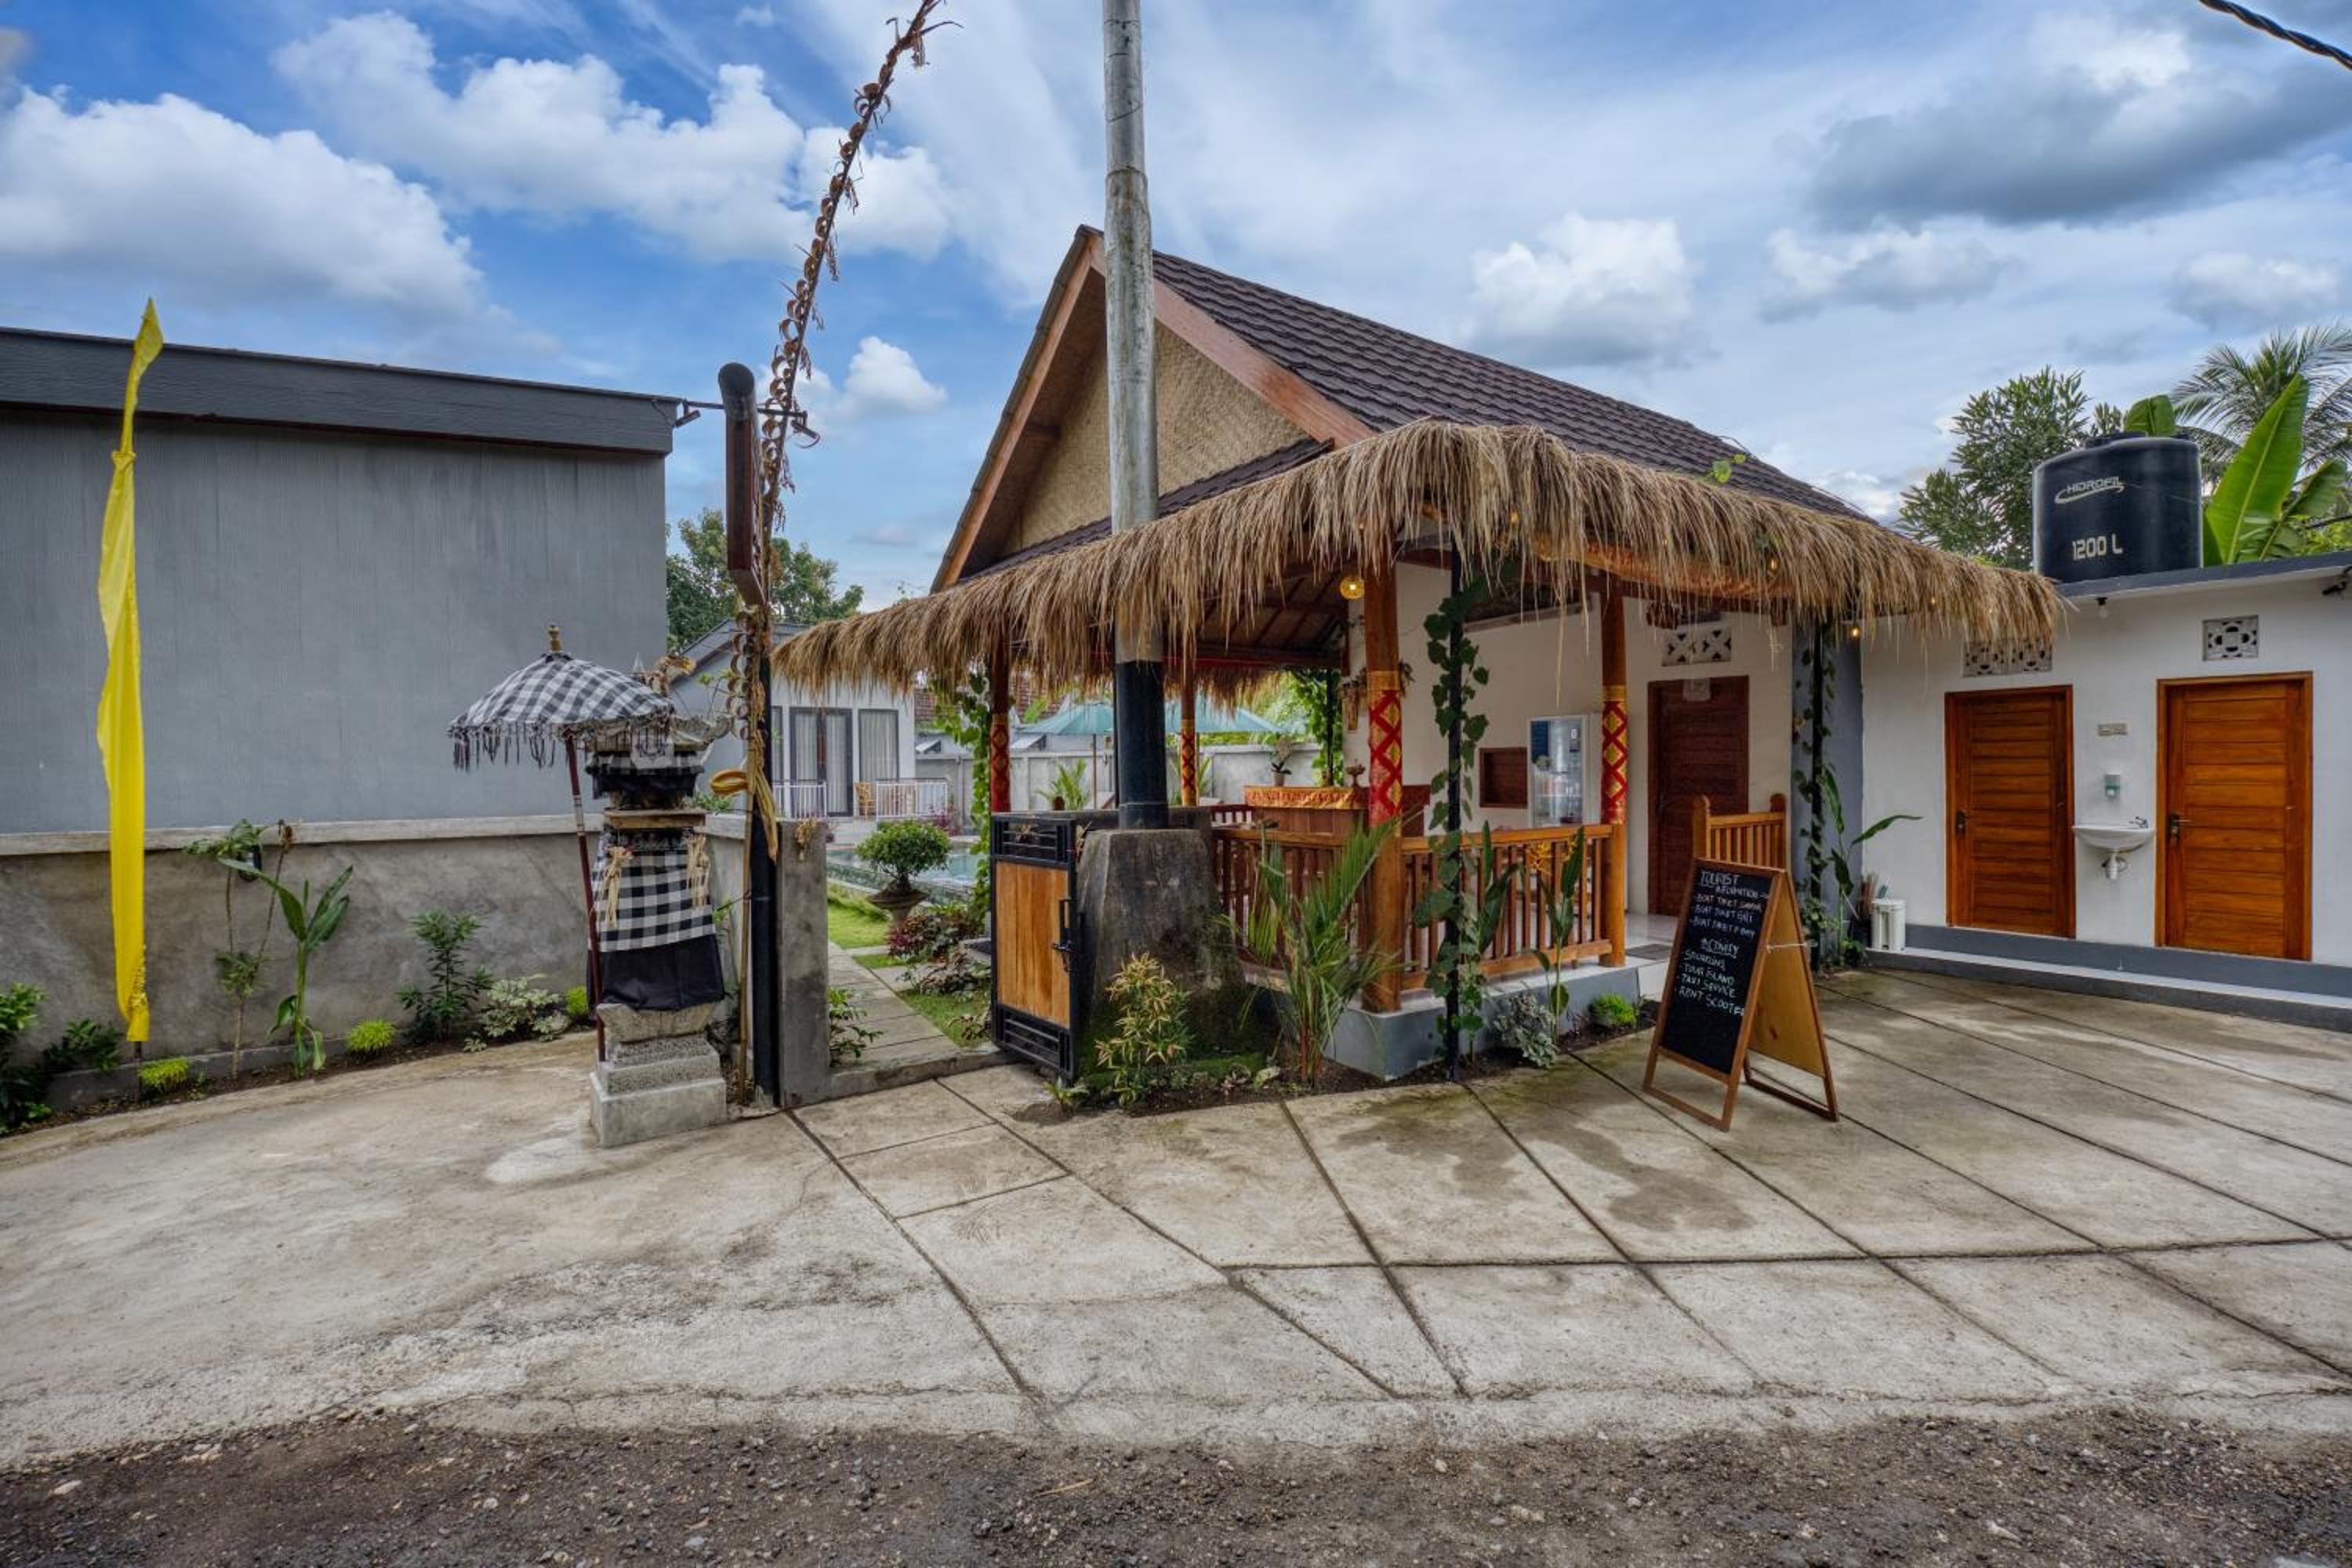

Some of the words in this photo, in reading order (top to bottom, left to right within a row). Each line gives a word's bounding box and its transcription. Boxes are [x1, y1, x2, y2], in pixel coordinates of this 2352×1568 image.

[2072, 535, 2107, 561] 1200
[2111, 533, 2123, 554] L
[1700, 870, 1740, 887] TOURIST
[1696, 894, 1715, 903] BOAT
[1695, 904, 1712, 914] BOAT
[1693, 916, 1711, 927] BOAT
[1684, 963, 1704, 975] TOUR
[1681, 973, 1700, 985] TAXI
[1679, 985, 1704, 1001] RENT
